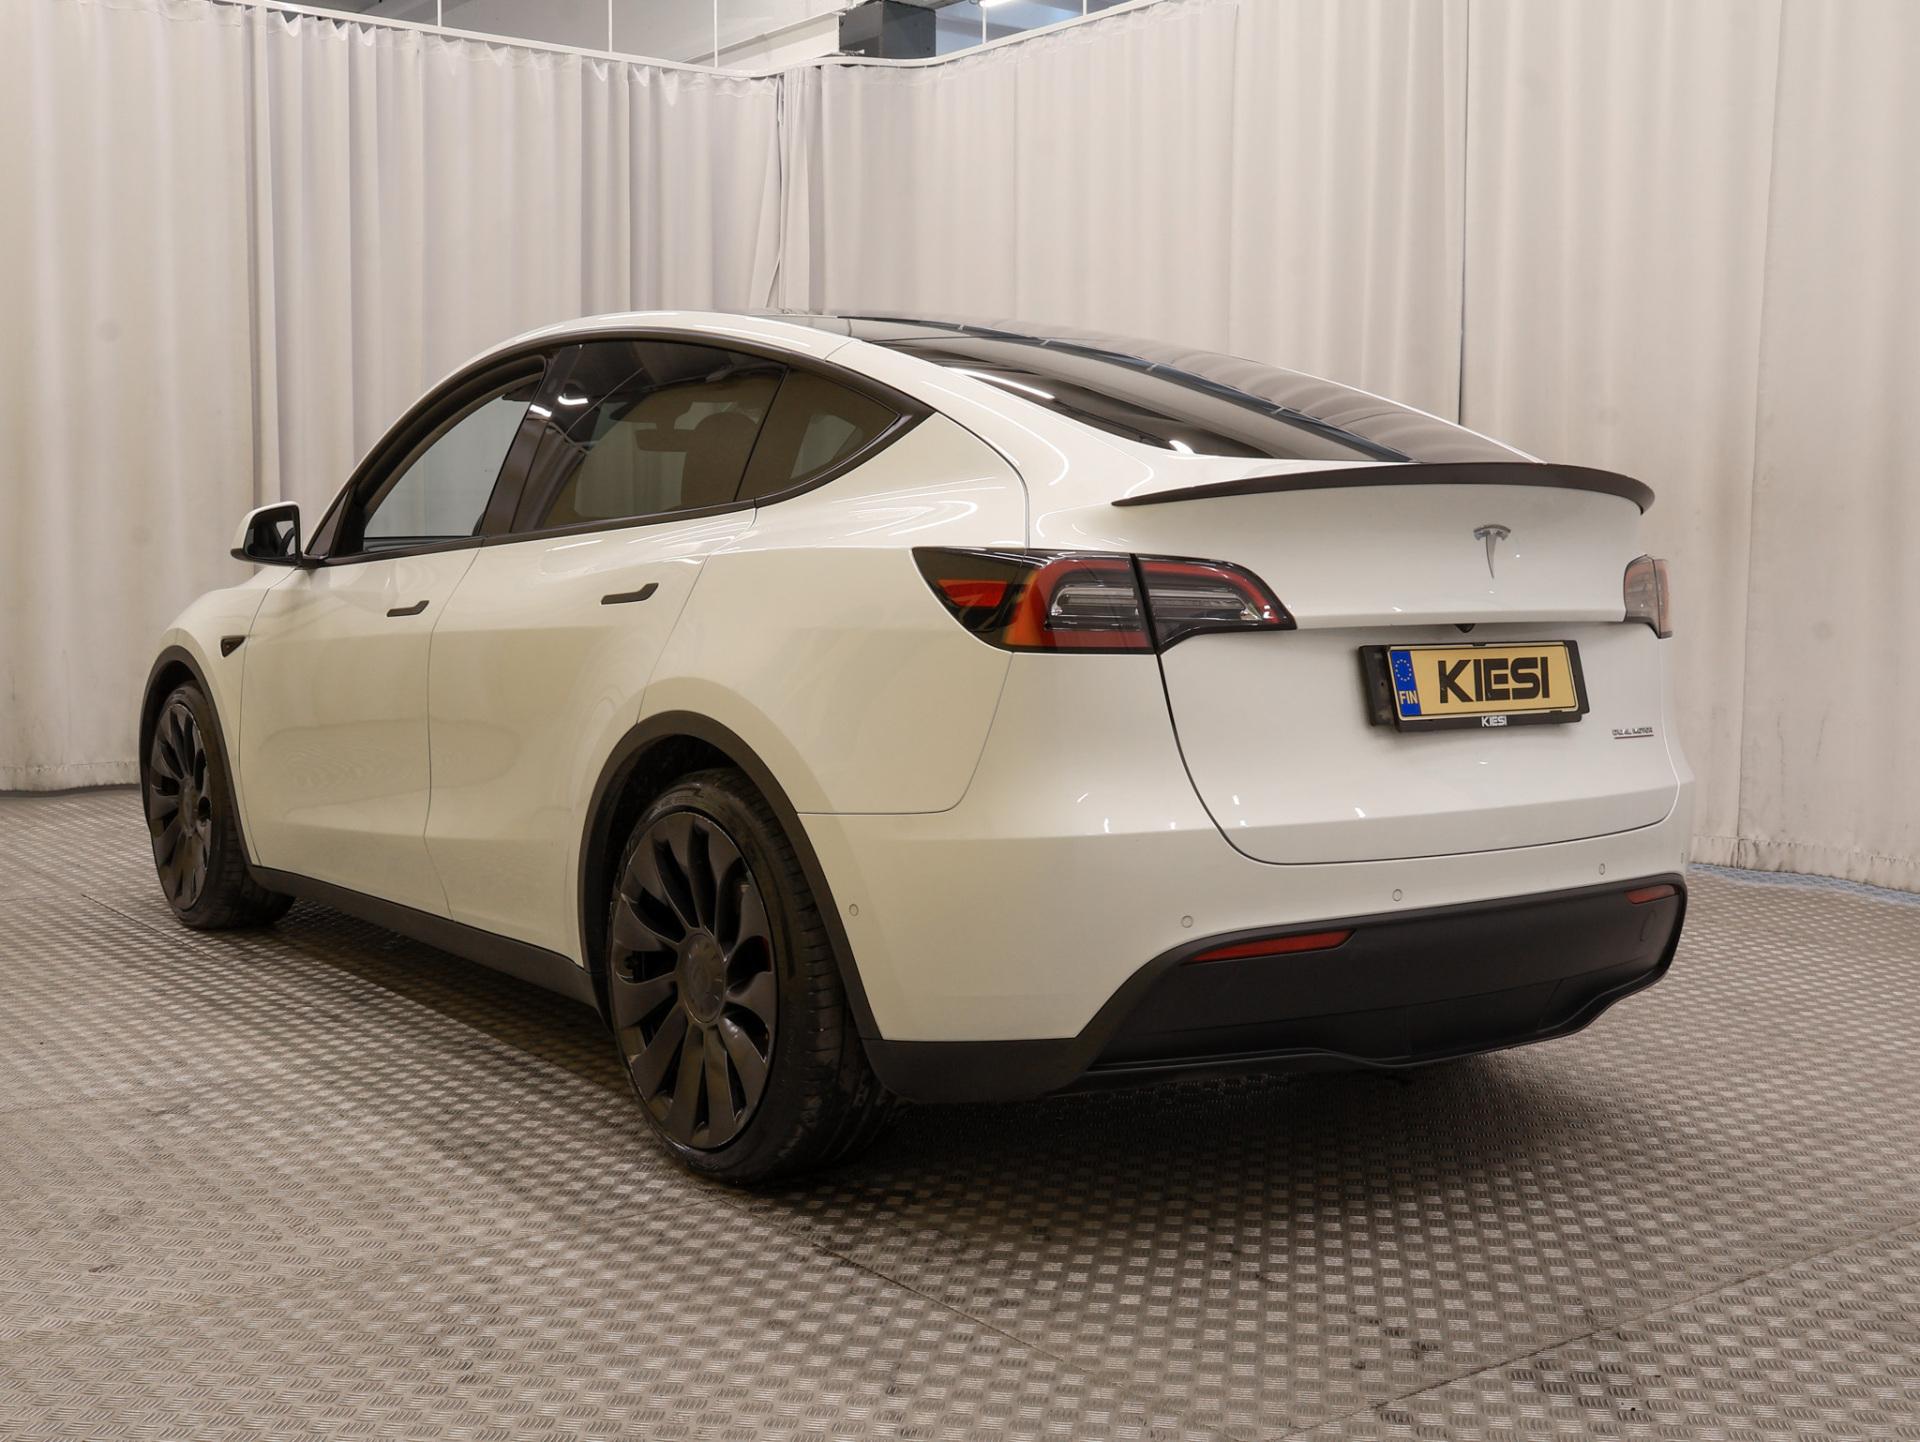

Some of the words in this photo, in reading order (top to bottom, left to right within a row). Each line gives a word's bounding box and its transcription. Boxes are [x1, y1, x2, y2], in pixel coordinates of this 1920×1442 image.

[1437, 656, 1550, 704] KIESI
[1399, 690, 1419, 705] FIN
[1481, 715, 1508, 728] KIESI
